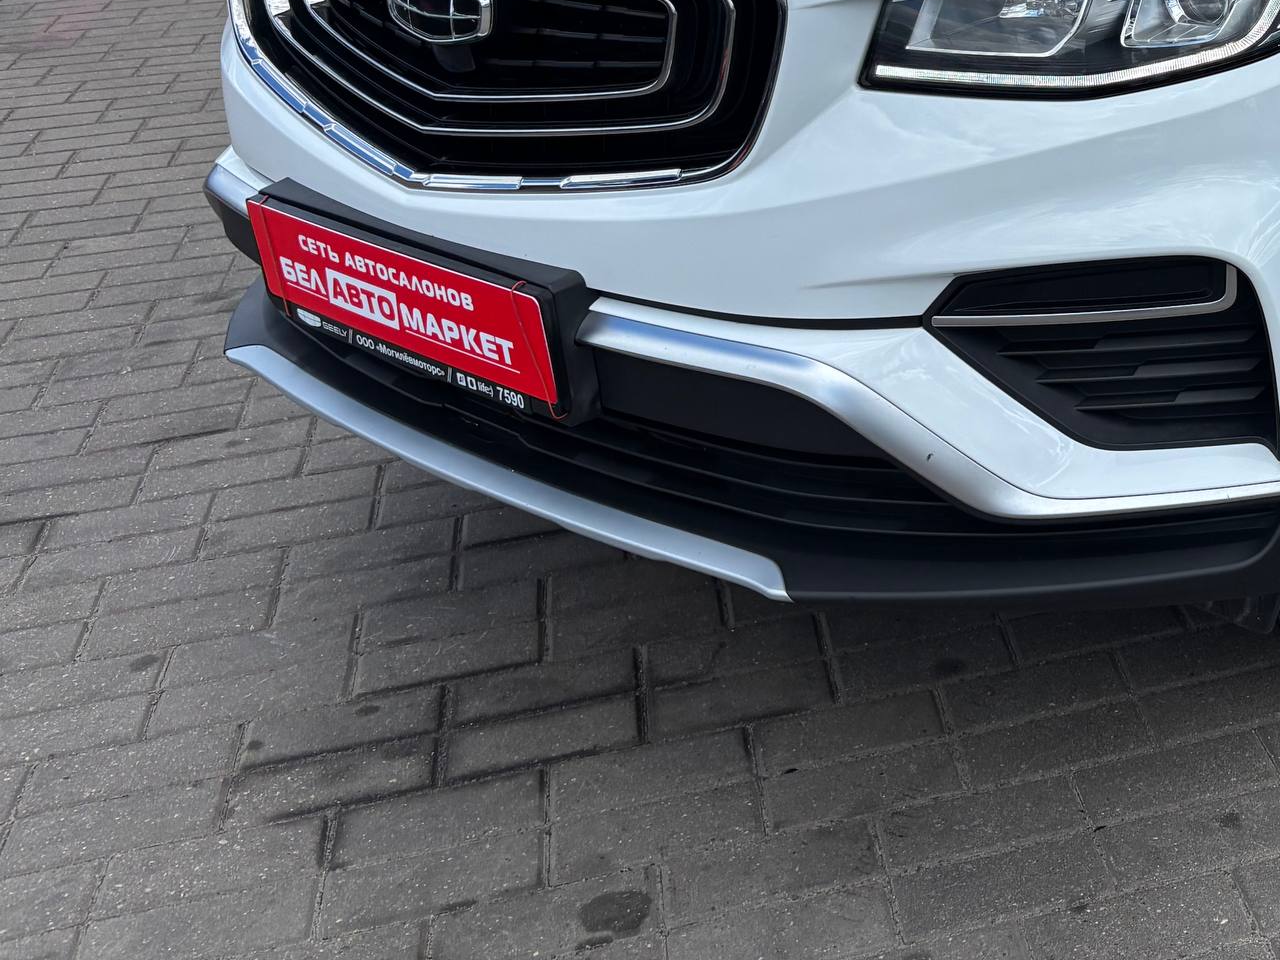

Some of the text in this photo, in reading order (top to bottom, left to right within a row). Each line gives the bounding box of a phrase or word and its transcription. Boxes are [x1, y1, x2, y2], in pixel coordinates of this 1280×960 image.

[298, 234, 474, 311] СЕТЬ АВТОСАЛОНОВ
[322, 321, 348, 337] GEELY
[356, 334, 375, 350] ООО
[496, 386, 524, 409] 7590
